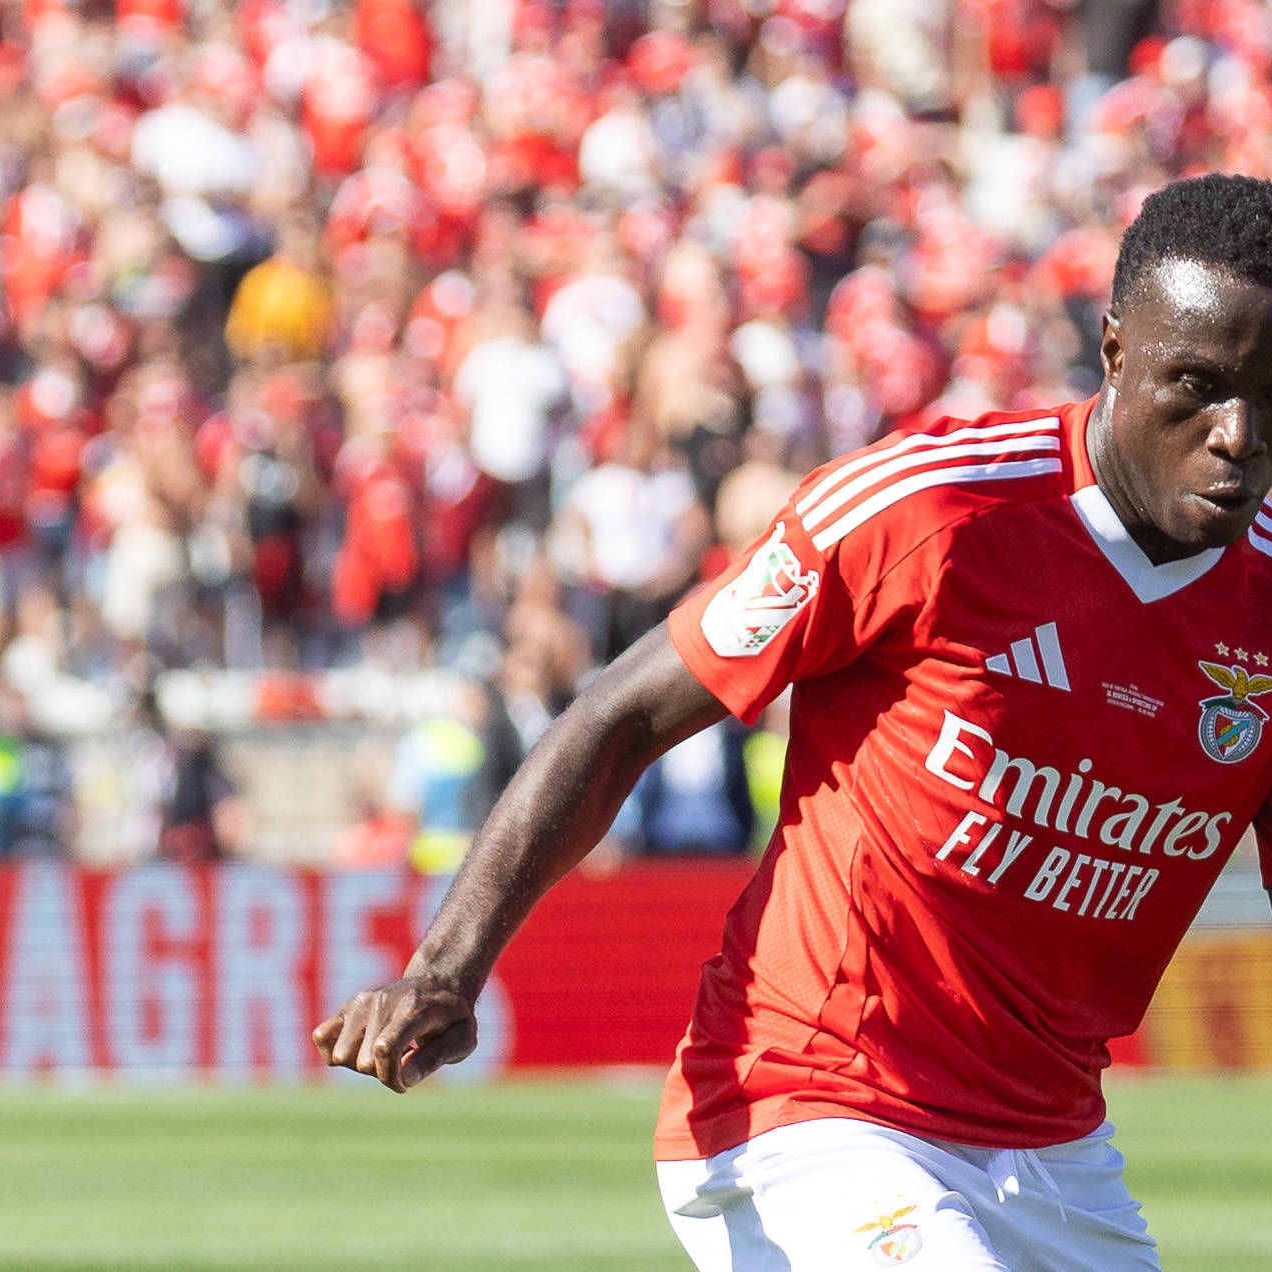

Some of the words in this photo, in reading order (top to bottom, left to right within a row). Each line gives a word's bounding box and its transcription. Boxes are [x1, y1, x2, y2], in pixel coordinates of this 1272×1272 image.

[924, 708, 1232, 861] Emirates
[935, 810, 1033, 884] FLY
[1023, 846, 1160, 921] BETTER
